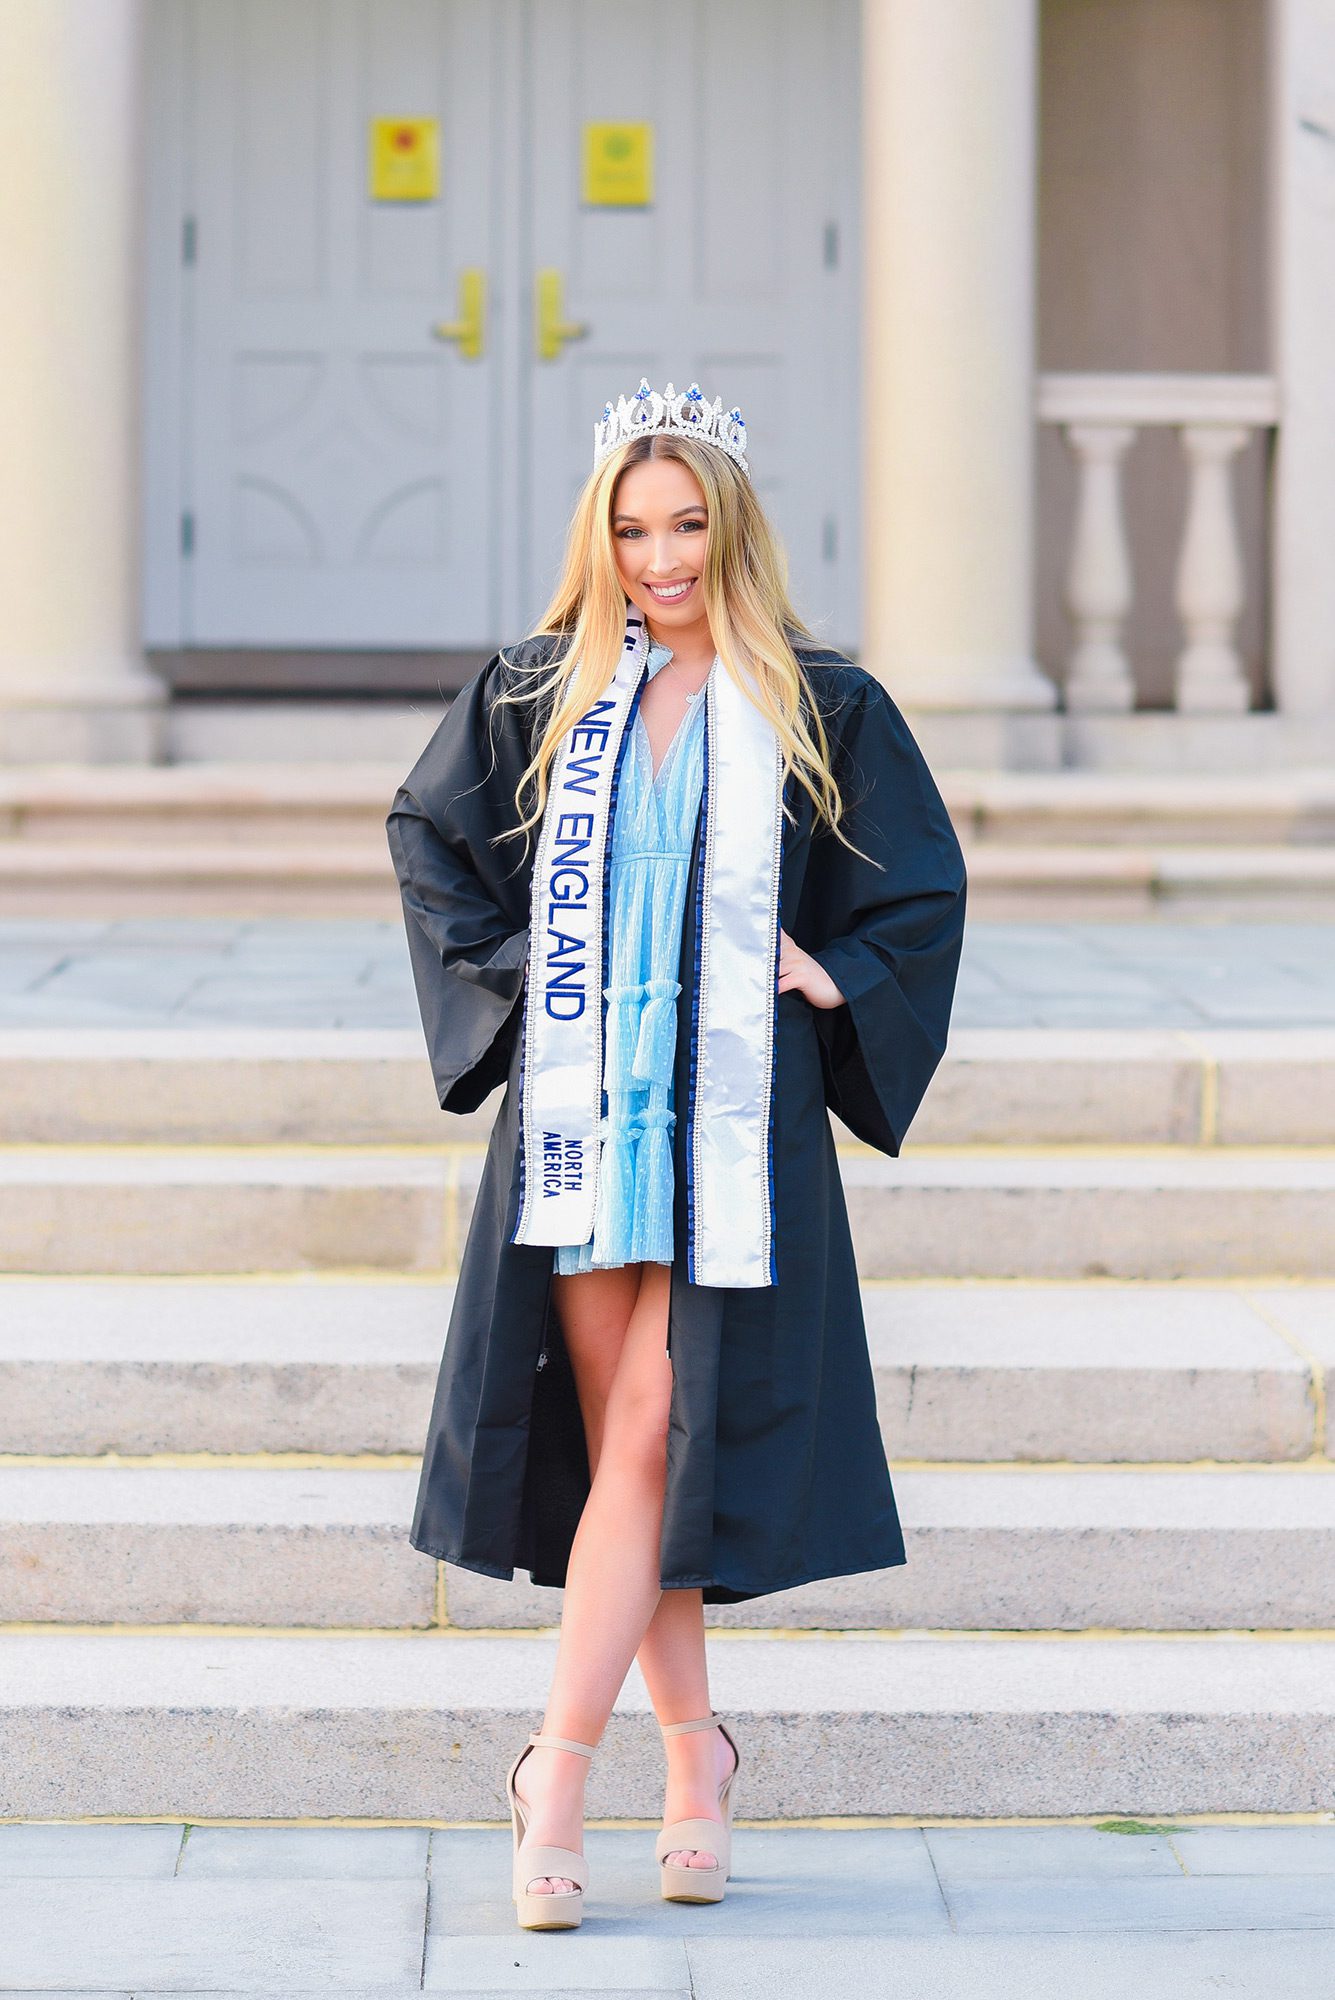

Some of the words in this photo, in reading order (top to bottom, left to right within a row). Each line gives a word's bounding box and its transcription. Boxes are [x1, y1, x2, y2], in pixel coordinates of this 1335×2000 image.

[563, 700, 617, 796] NEW
[545, 813, 595, 1021] ENGLAND
[542, 1131, 562, 1198] AMERICA
[564, 1140, 583, 1191] NORTH
